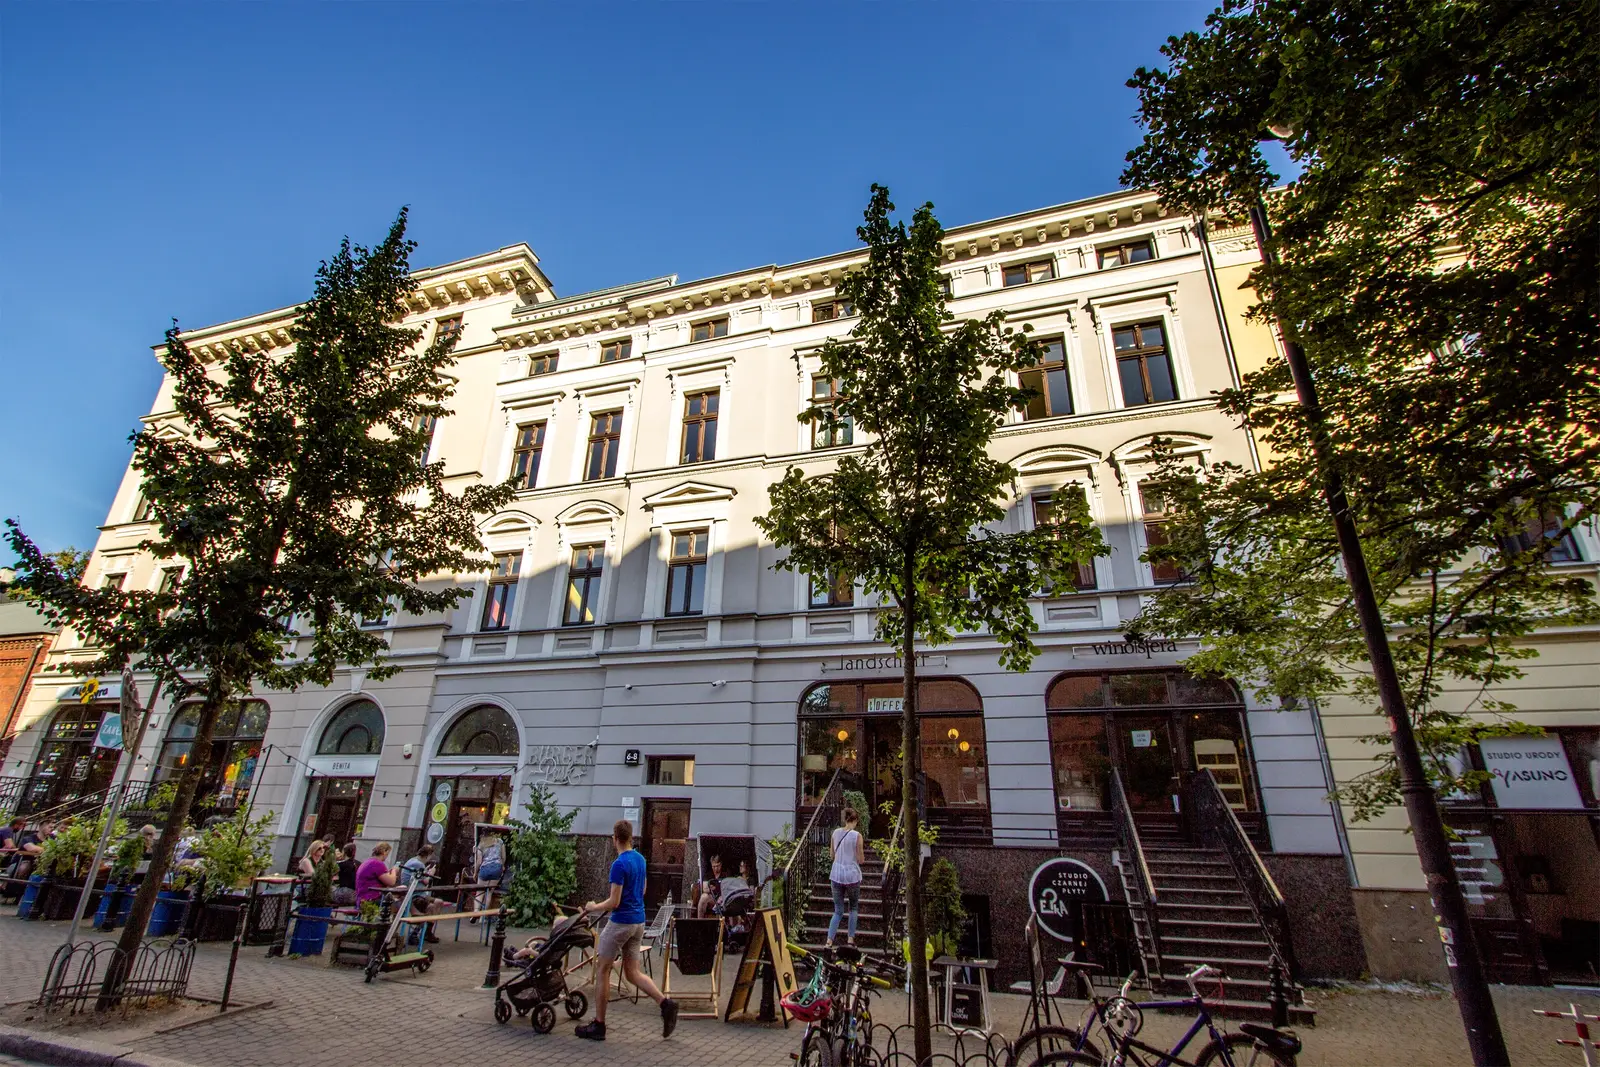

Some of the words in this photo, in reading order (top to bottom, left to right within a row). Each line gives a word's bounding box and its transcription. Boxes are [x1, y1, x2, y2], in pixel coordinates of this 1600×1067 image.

[868, 700, 906, 711] COFFE
[1487, 752, 1522, 760] STUDIO
[1525, 751, 1561, 760] URODY
[332, 762, 351, 770] BENITA
[1493, 768, 1568, 788] YASUNO
[1058, 872, 1089, 880] STUDIO
